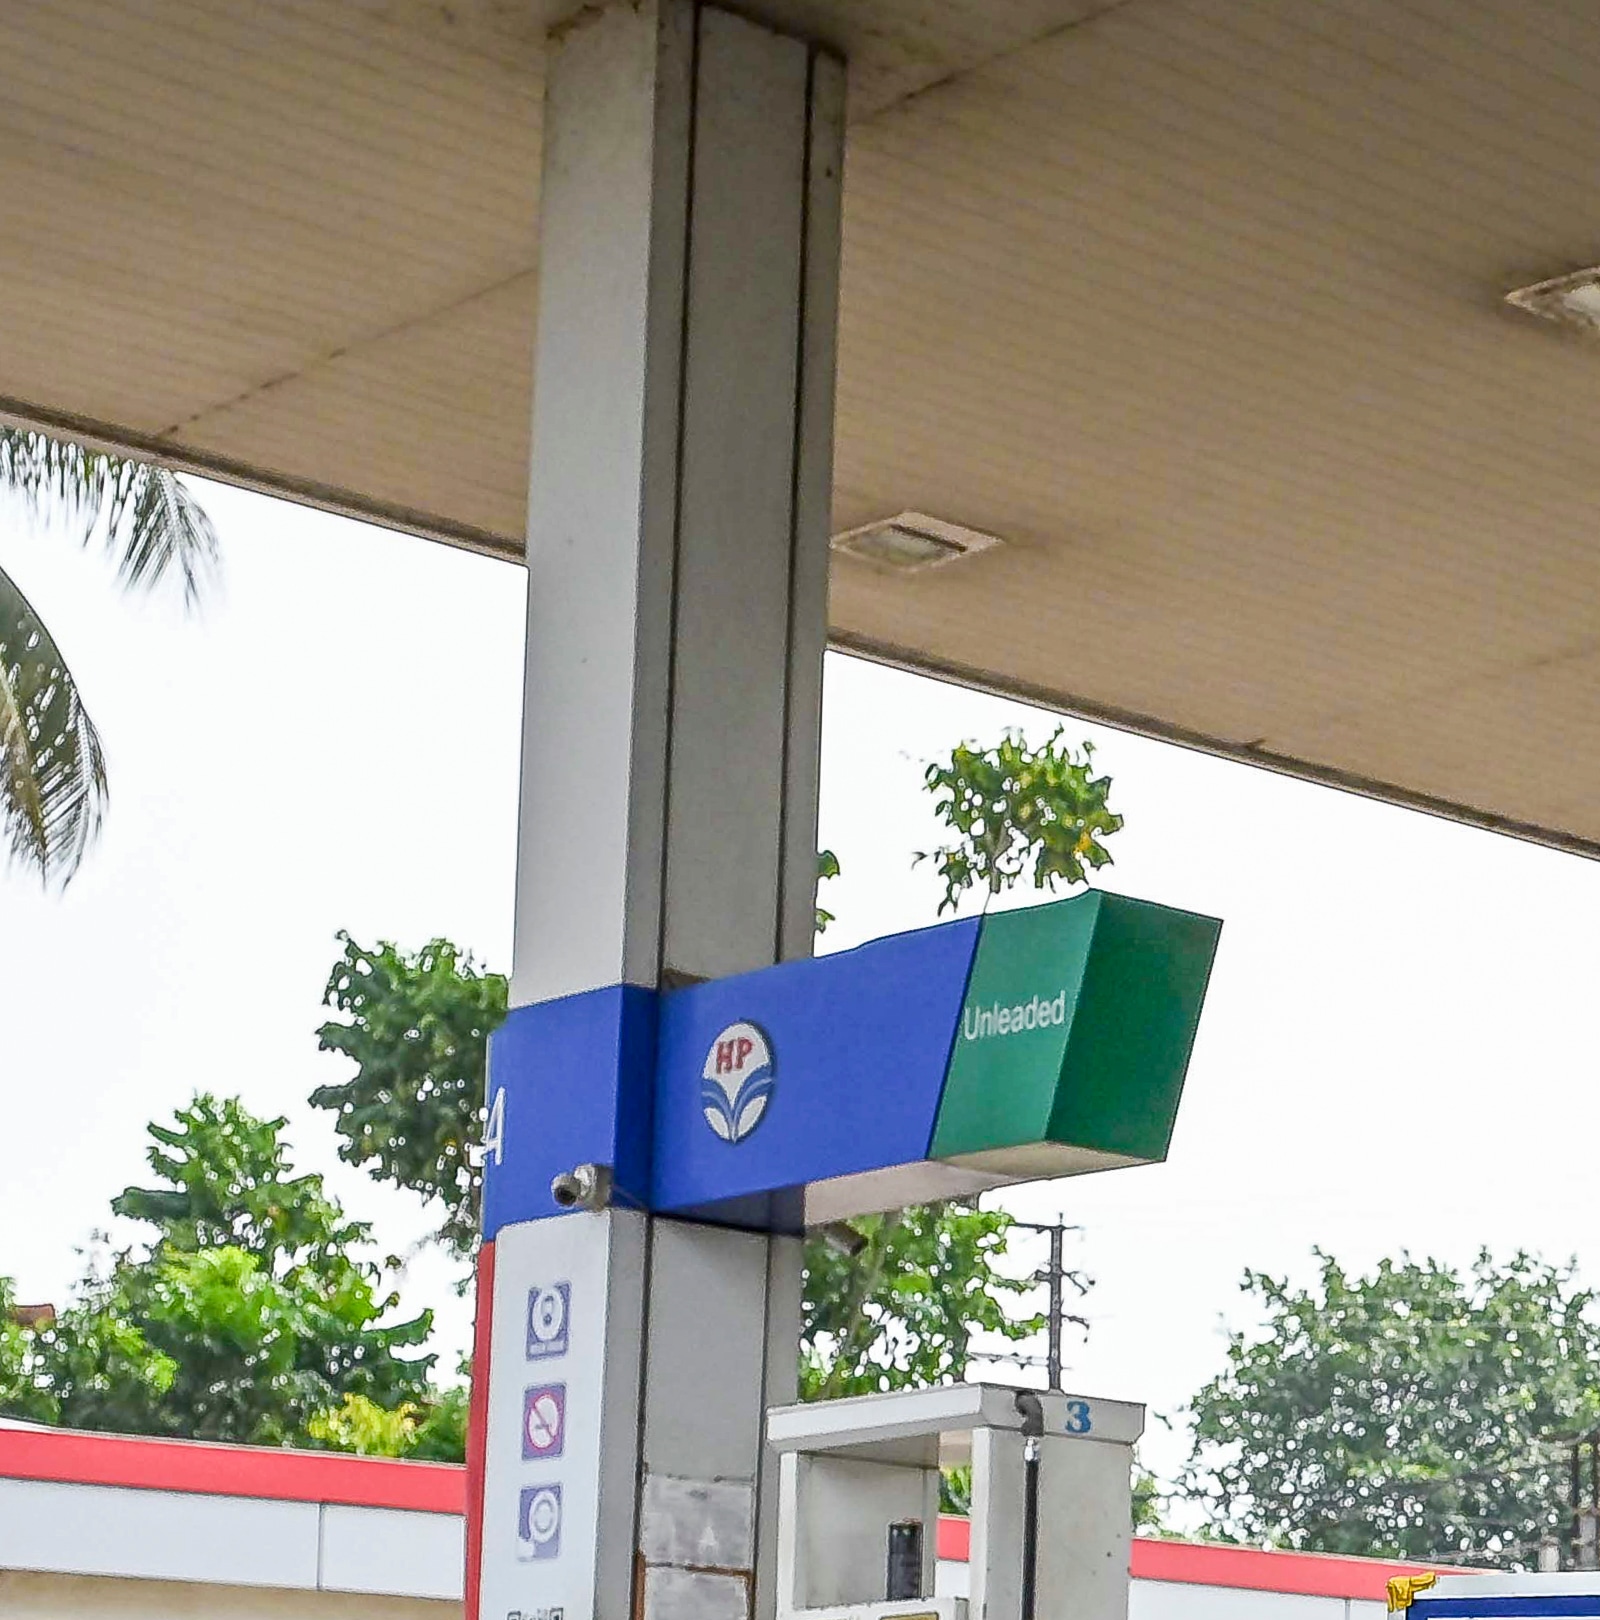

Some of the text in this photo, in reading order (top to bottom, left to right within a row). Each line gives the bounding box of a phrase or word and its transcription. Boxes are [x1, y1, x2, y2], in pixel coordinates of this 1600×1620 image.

[962, 989, 1067, 1043] Unleaded
[715, 1036, 753, 1074] HP
[1064, 1401, 1092, 1435] 3
